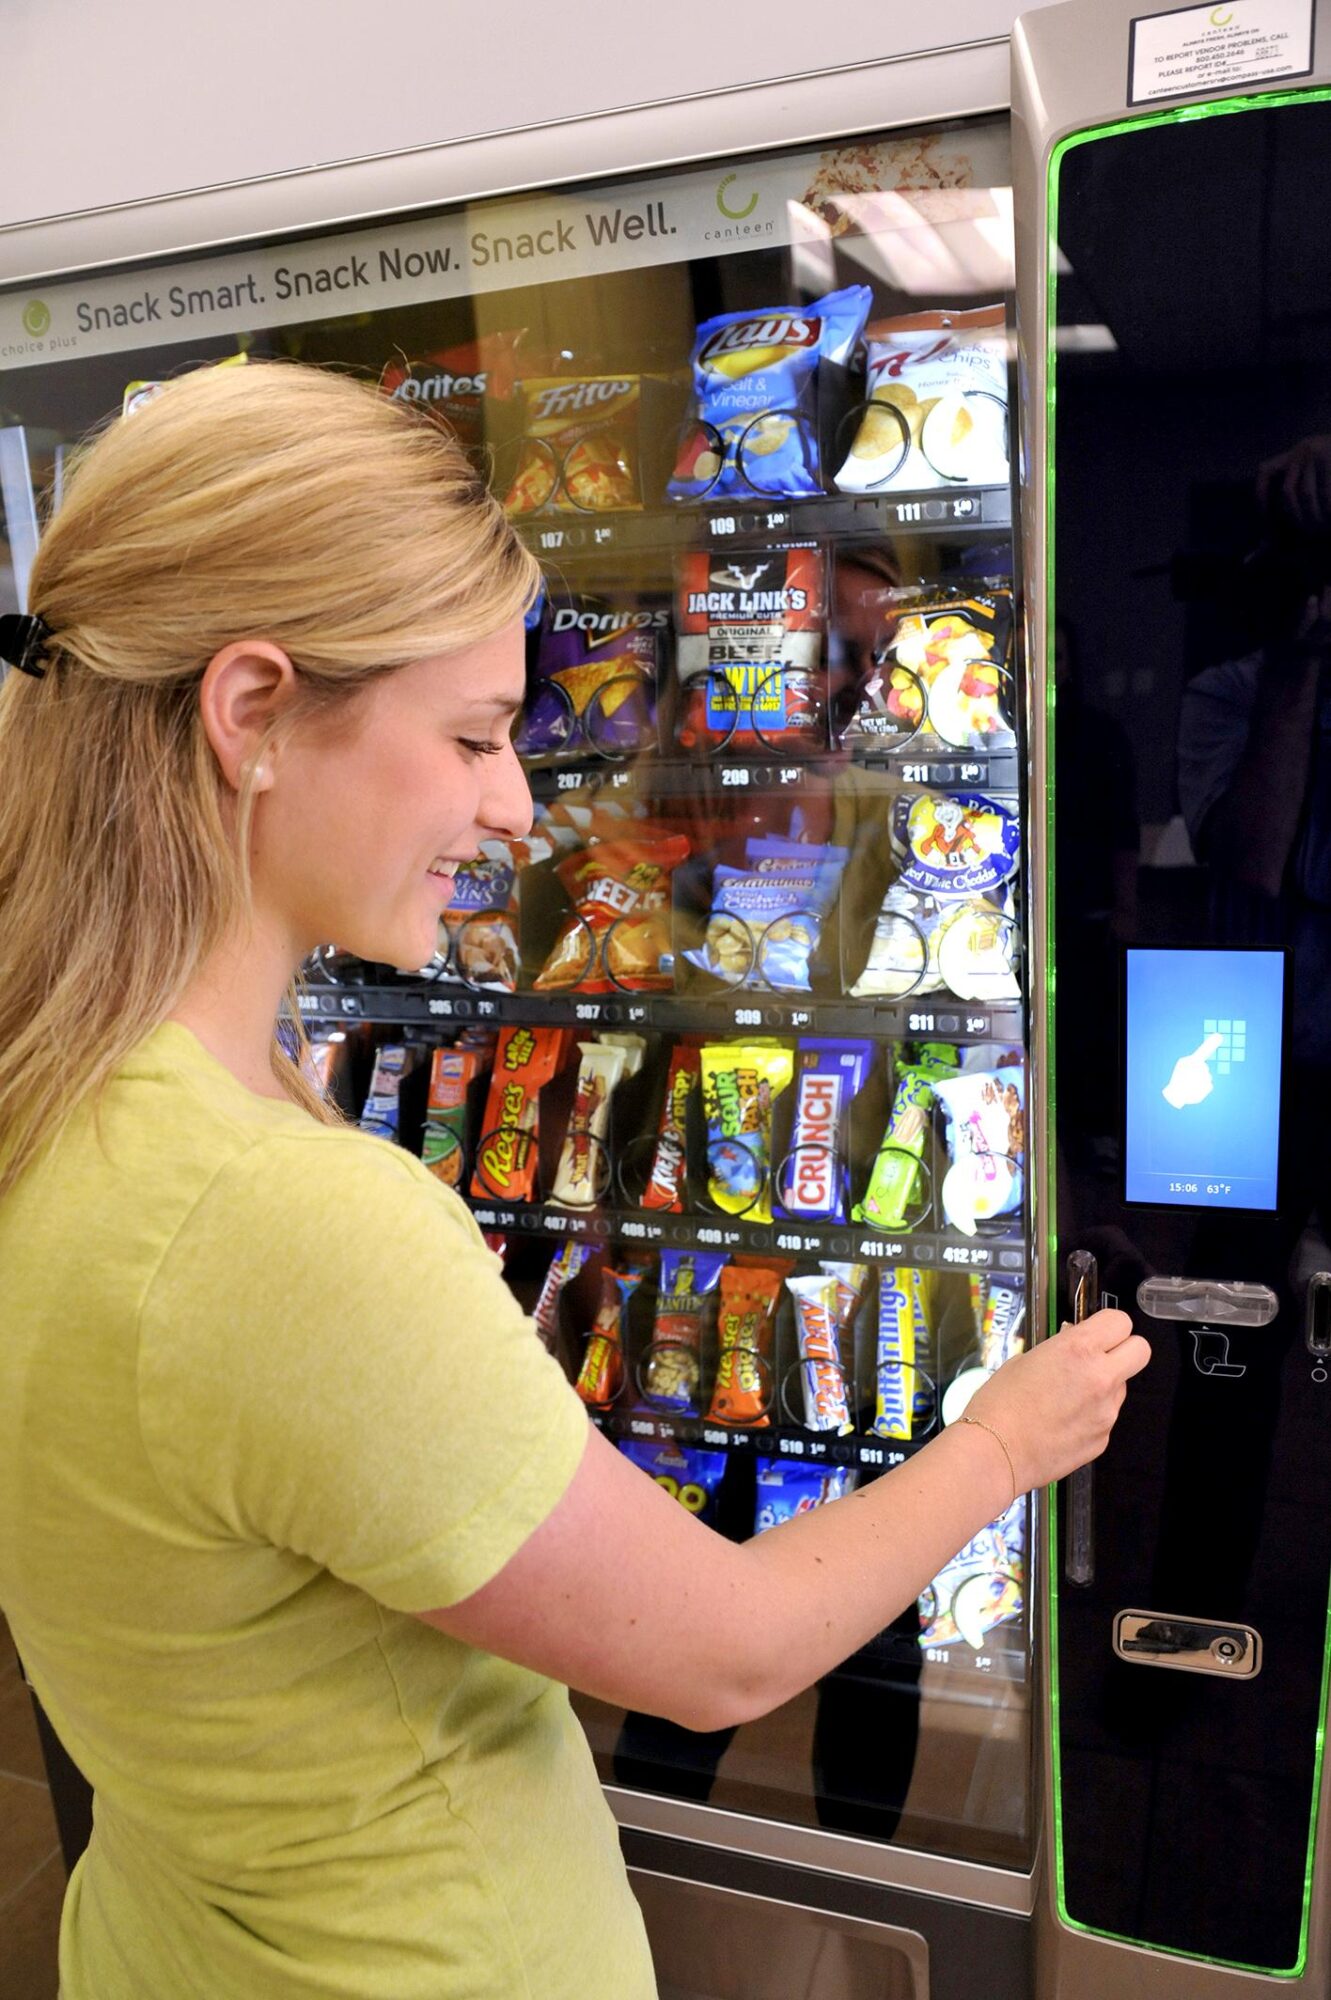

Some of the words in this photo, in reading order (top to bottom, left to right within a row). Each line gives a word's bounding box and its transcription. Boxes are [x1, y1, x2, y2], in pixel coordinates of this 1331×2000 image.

[1165, 50, 1193, 62] REPORT
[1195, 44, 1226, 55] VENDOR
[1227, 36, 1269, 49] PROBLEMS,
[1270, 32, 1289, 41] CALL
[1158, 67, 1184, 78] PLEASE
[1184, 62, 1213, 73] REPORT
[1207, 67, 1231, 77] e-mail
[704, 221, 772, 241] canteen
[76, 292, 162, 333] Snack
[169, 274, 266, 318] Smart.
[275, 256, 371, 300] Snack
[379, 246, 461, 282] Now.
[470, 219, 577, 267] Snack
[585, 202, 677, 247] Well.
[1, 342, 44, 357] choice
[49, 336, 77, 352] plus
[721, 376, 753, 391] Salt
[755, 377, 767, 391] &
[535, 381, 631, 419] Fritos
[710, 392, 775, 410] Vinegar
[896, 503, 921, 522] 111
[709, 516, 736, 535] 109
[540, 531, 565, 549] 107
[688, 592, 735, 614] JACK
[739, 588, 806, 612] LINK'S
[553, 607, 670, 632] Doritos
[716, 627, 774, 636] ORIGINAL
[709, 645, 782, 660] BEEF
[724, 666, 782, 695] WIN!
[558, 773, 582, 789] 207
[722, 768, 749, 786] 209
[902, 765, 929, 783] 211
[924, 871, 952, 890] White
[952, 867, 998, 890] Cheddar
[576, 1004, 600, 1020] 307
[735, 1009, 761, 1025] 309
[909, 1014, 934, 1032] 311
[505, 1029, 531, 1071] LARGE
[672, 1068, 690, 1130] CRISPY
[716, 1072, 741, 1137] SOUR
[735, 1068, 759, 1134] PATCH
[482, 1081, 525, 1188] Reese's
[797, 1079, 834, 1205] CRUNCH
[1169, 1182, 1198, 1193] 15:06
[1206, 1183, 1231, 1194] 63°F
[544, 1216, 566, 1230] 407
[697, 1228, 722, 1243] 409
[777, 1235, 801, 1249] 410
[860, 1241, 883, 1256] 411
[943, 1247, 970, 1264] 412
[991, 1289, 1014, 1333] KIND
[779, 1439, 804, 1454] 510
[860, 1448, 883, 1464] 511
